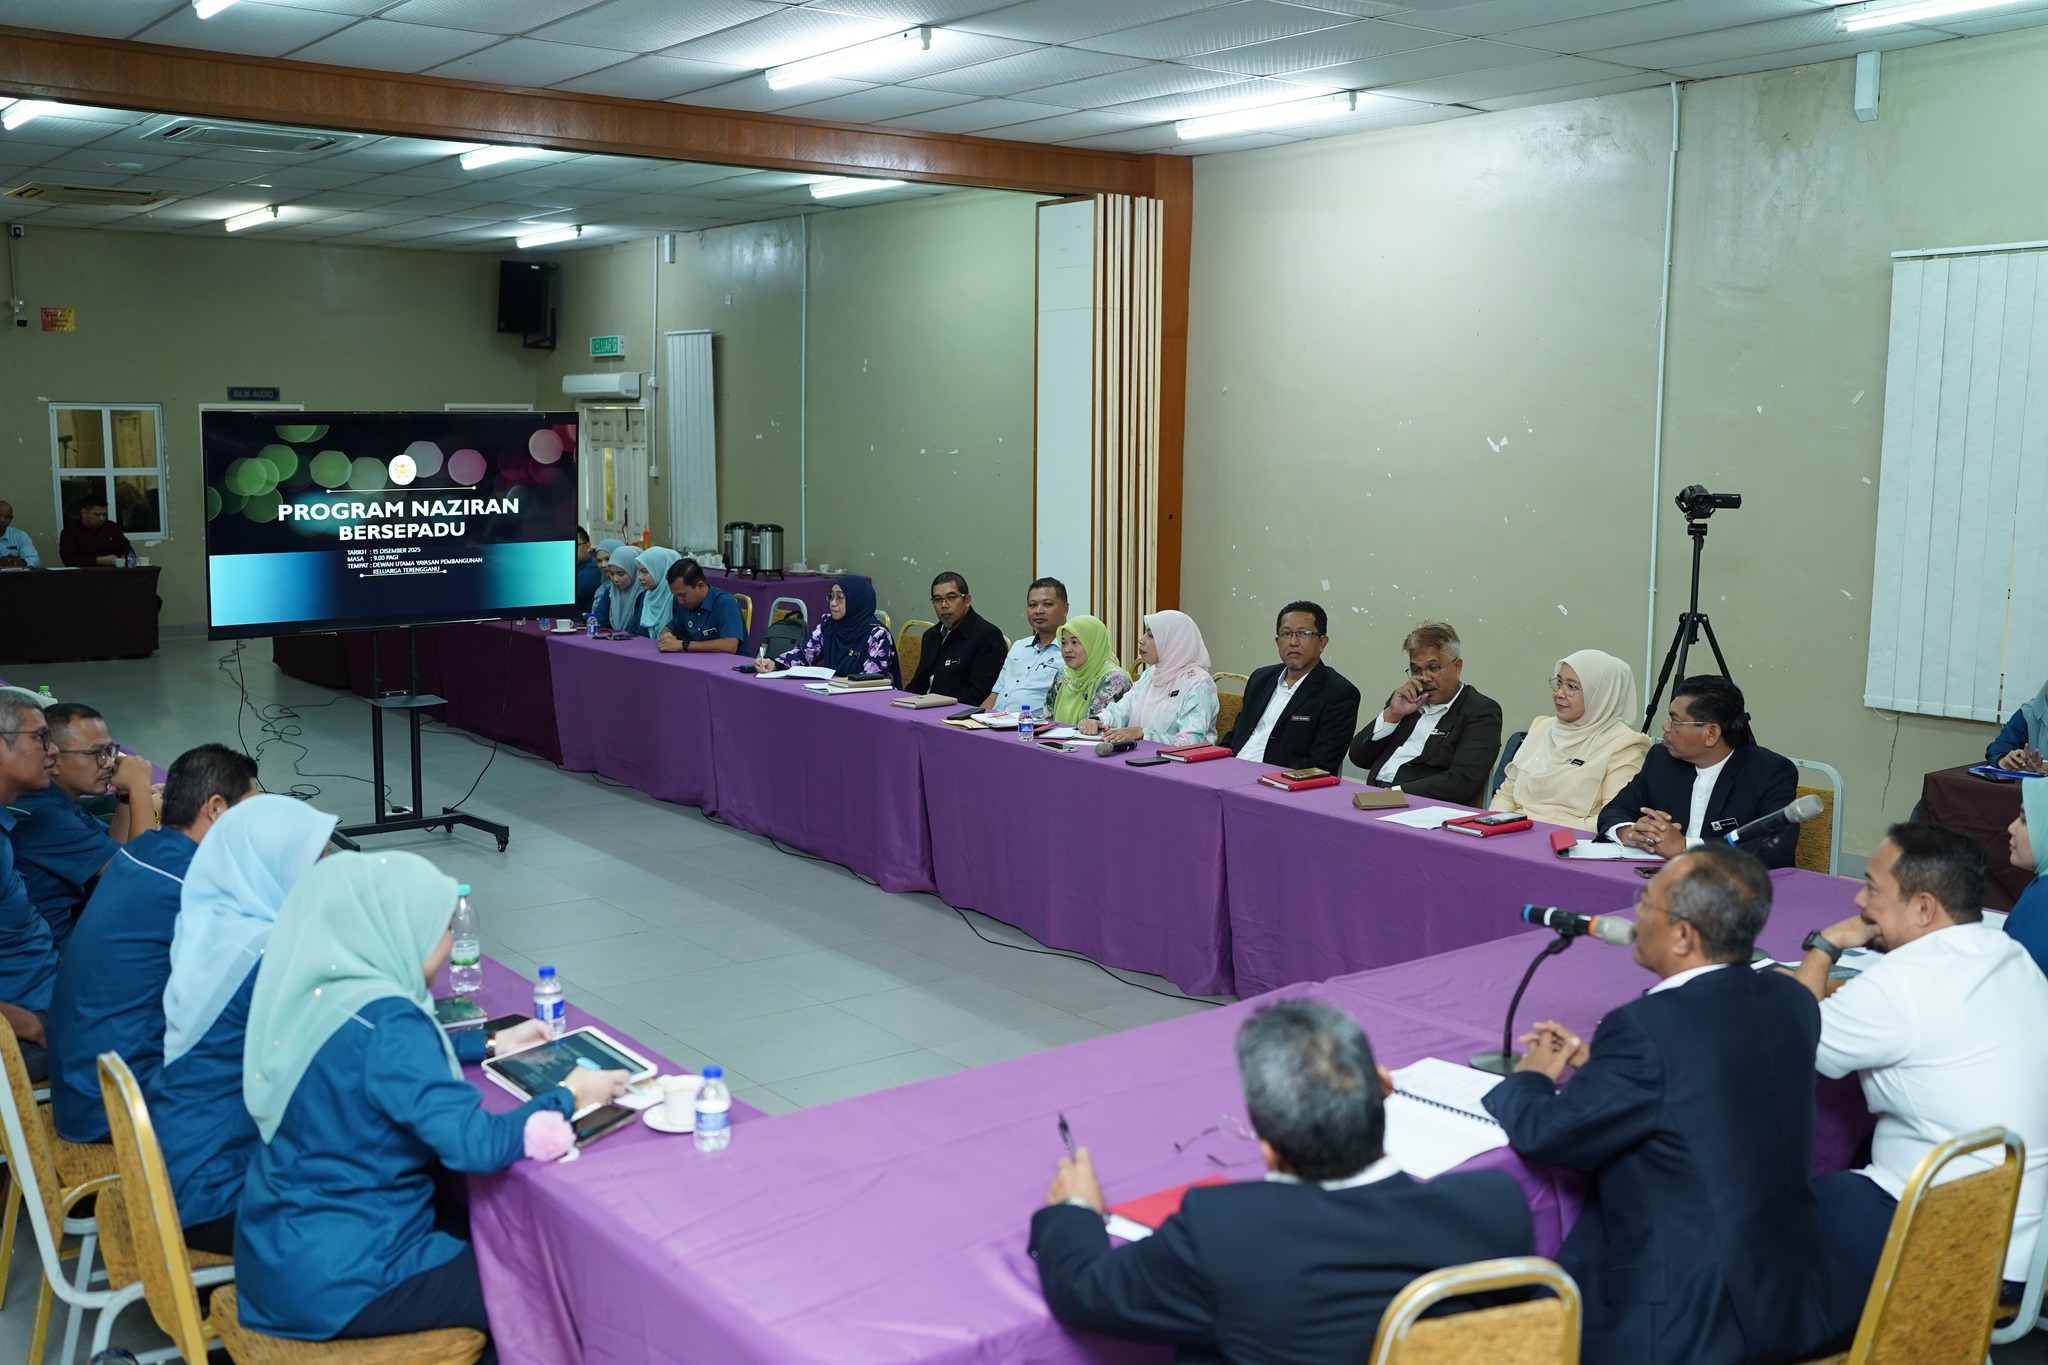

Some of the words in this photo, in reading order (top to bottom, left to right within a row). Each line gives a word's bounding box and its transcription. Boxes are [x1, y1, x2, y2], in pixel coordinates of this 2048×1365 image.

[253, 390, 273, 398] AUDIO
[278, 501, 404, 521] PROGRAM
[412, 498, 519, 518] NAZIRAN
[339, 522, 465, 541] BERSEPADU
